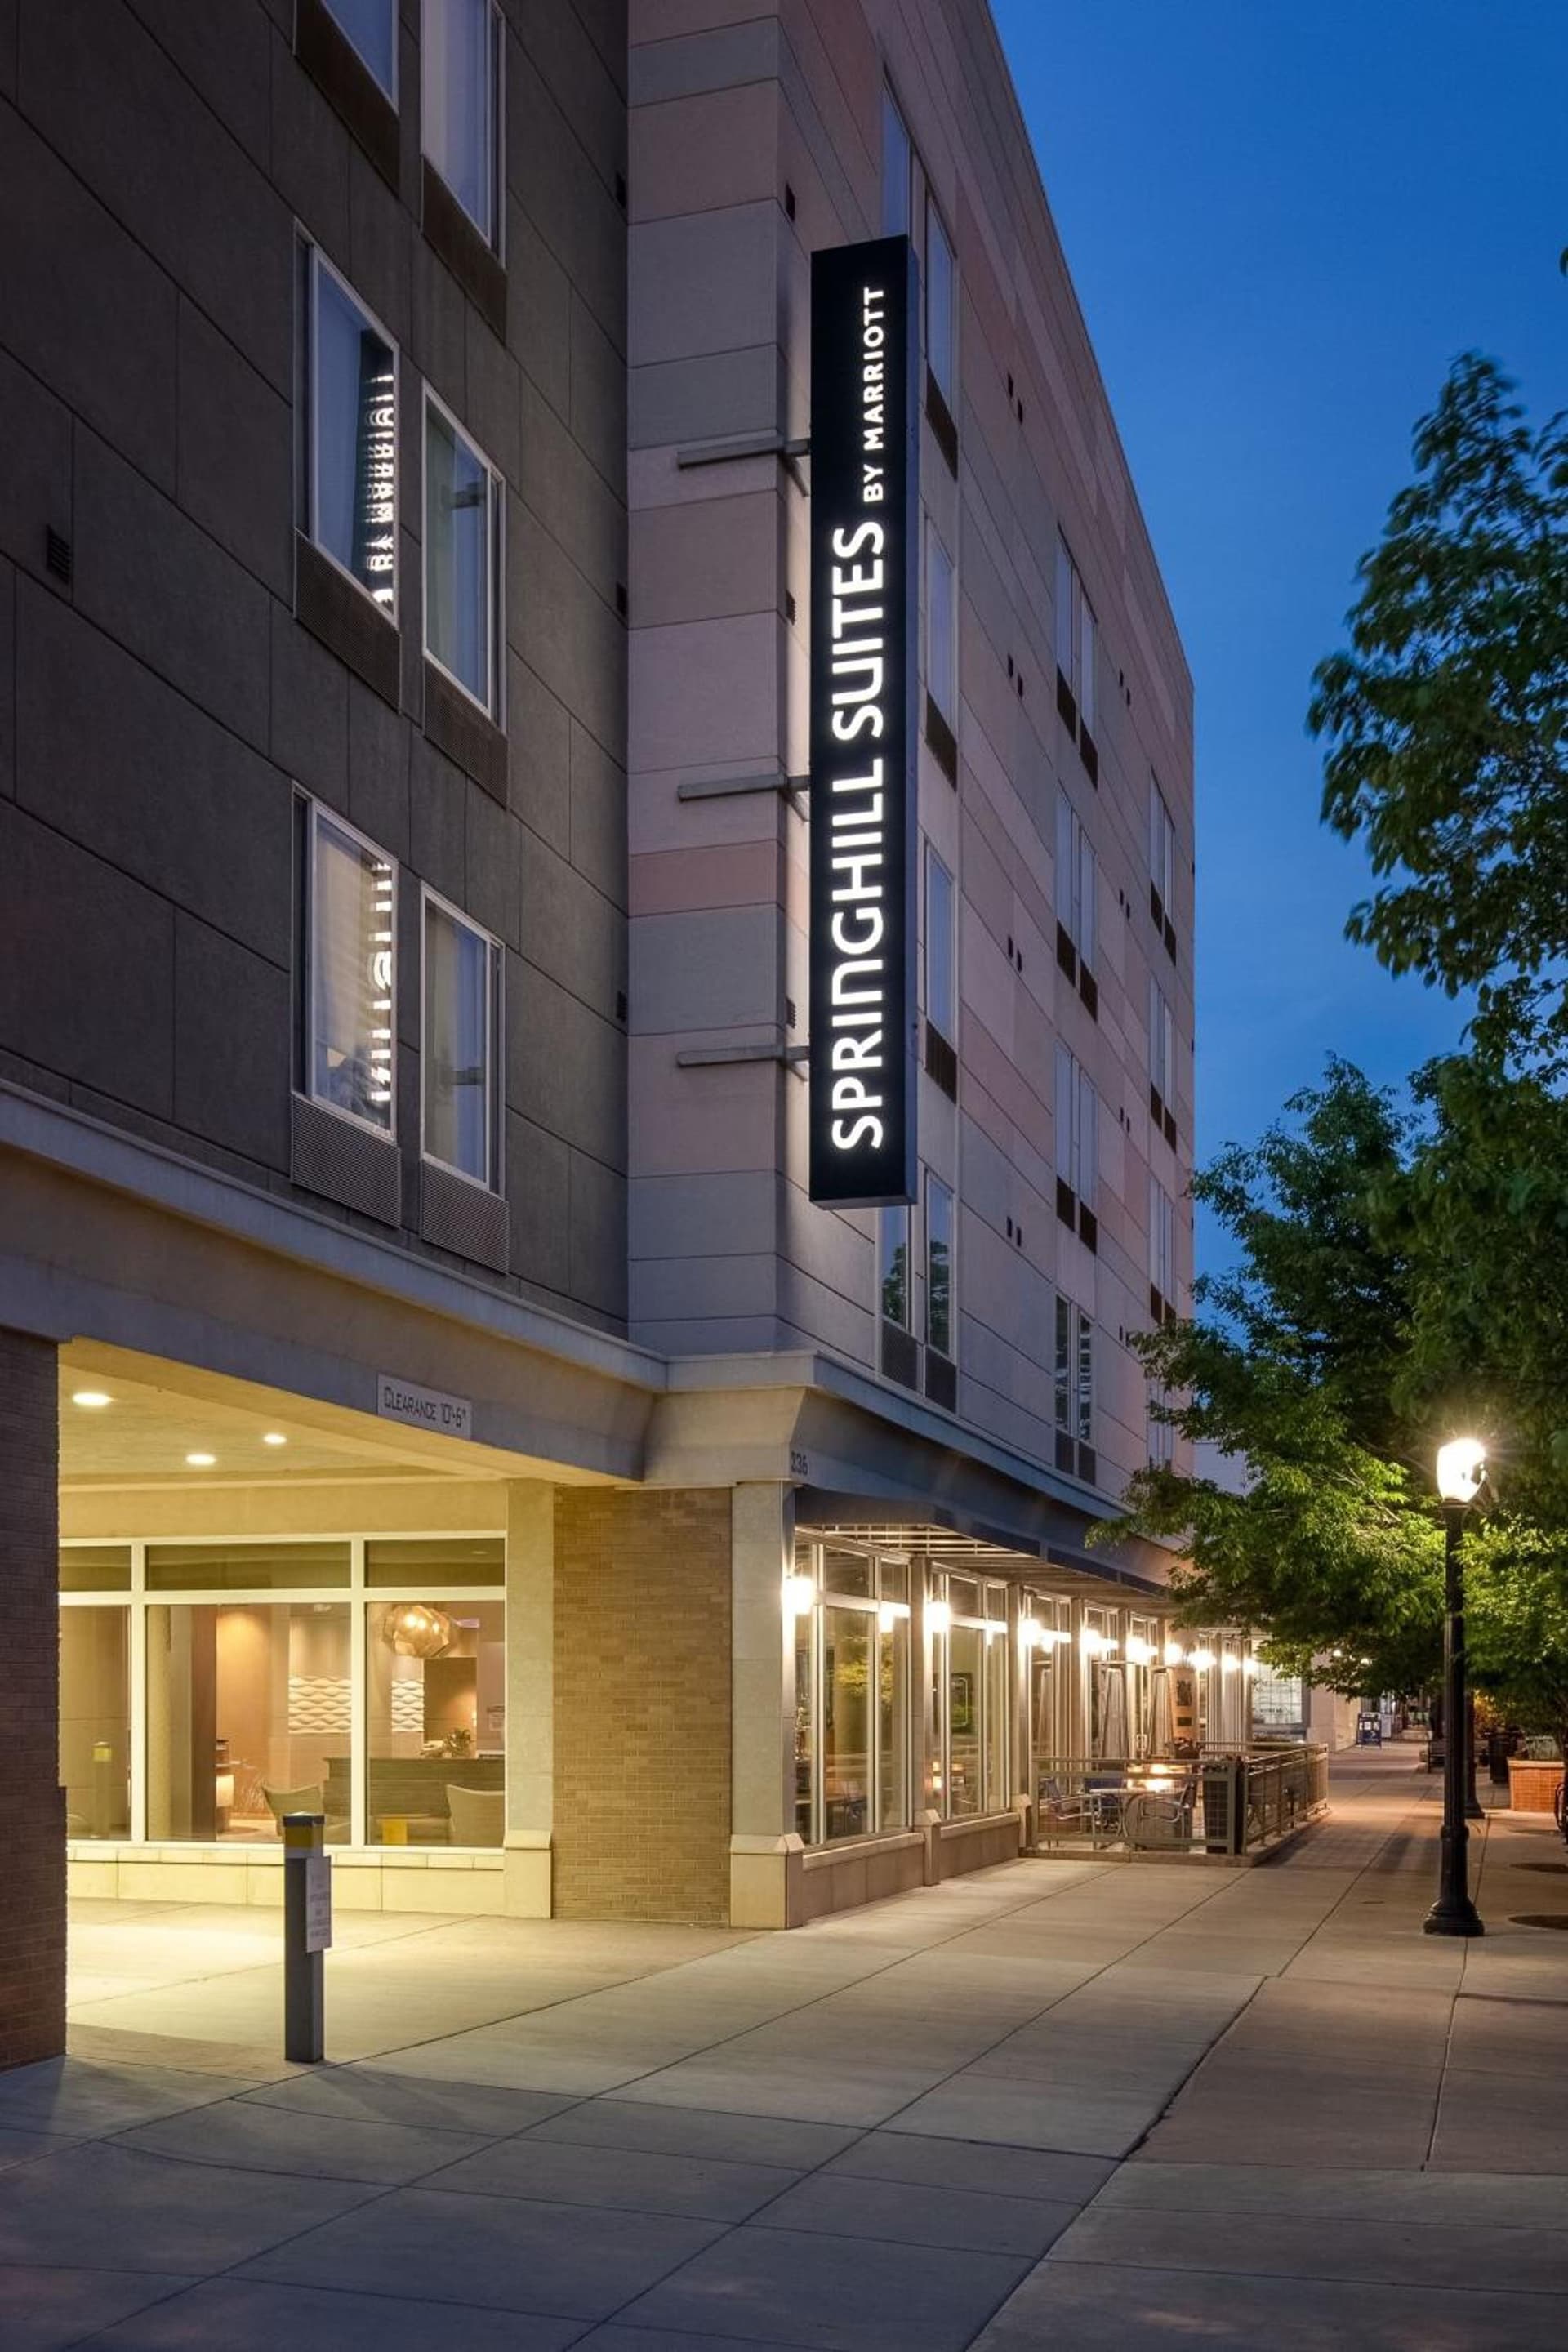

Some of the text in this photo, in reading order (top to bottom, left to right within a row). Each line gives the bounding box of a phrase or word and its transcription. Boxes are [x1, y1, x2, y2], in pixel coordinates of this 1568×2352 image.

[831, 287, 884, 1150] SPRINGHILL SUITES BY MARRIOTT
